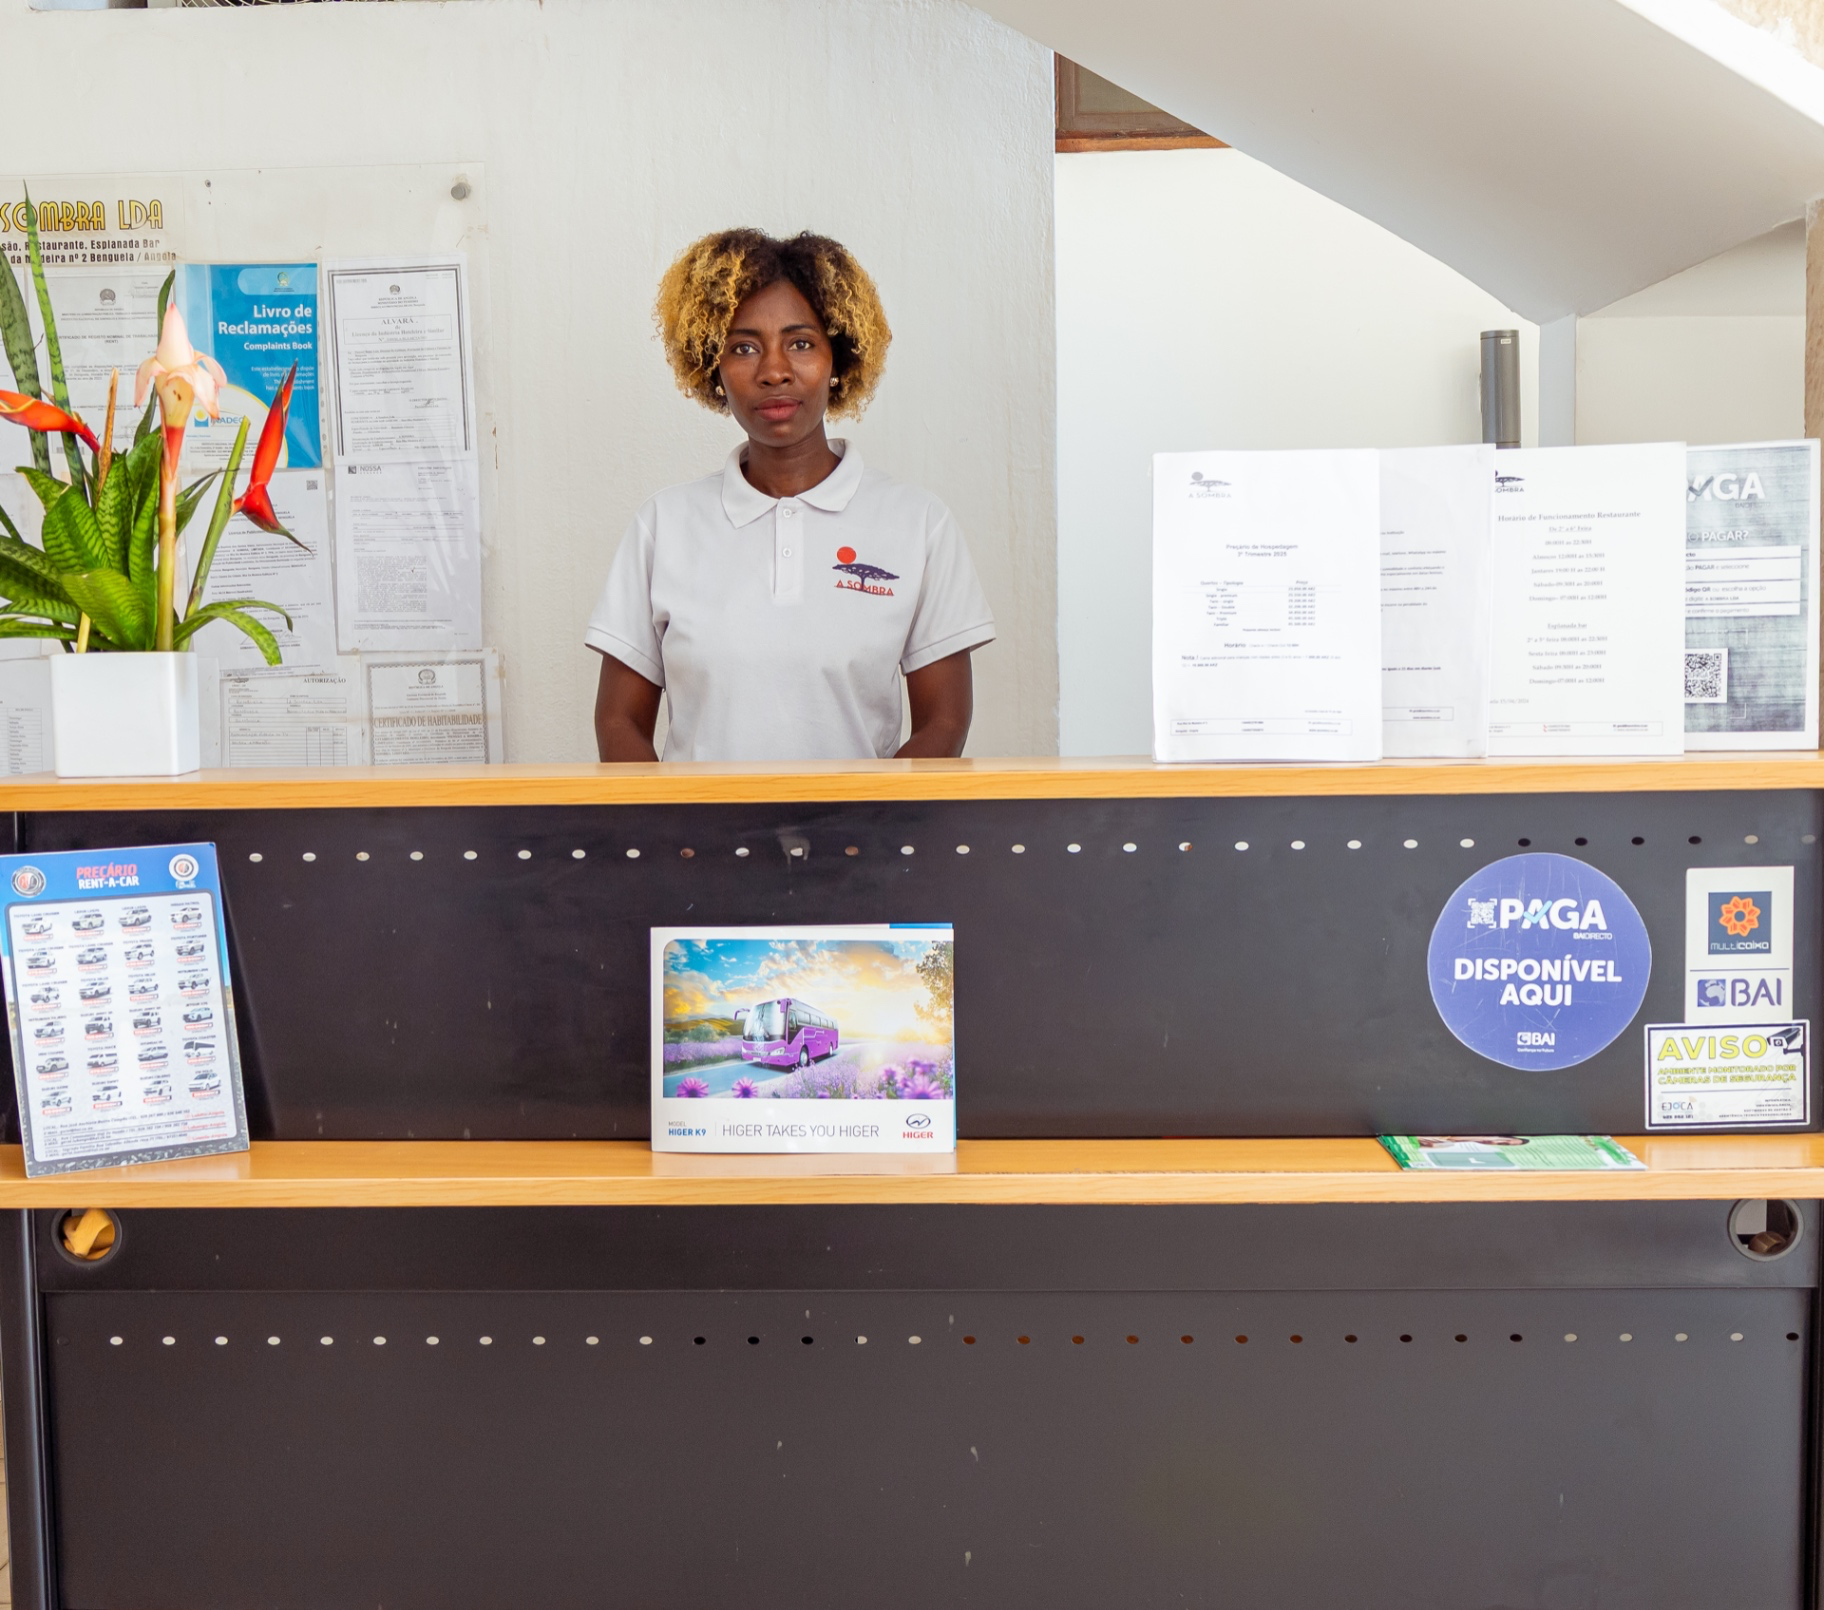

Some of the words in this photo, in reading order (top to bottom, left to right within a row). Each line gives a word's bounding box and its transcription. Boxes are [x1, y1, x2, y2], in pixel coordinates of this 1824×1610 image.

[118, 199, 164, 230] LDA
[2, 240, 21, 252] são.
[24, 240, 88, 251] Rstaurante.
[91, 240, 140, 250] Esplanada
[143, 238, 160, 249] Bar
[10, 254, 22, 264] da
[25, 254, 66, 264] Mdeira
[82, 254, 88, 262] 2
[90, 252, 134, 262] Benguela
[144, 251, 176, 262] Angola
[254, 304, 291, 318] Livro
[294, 304, 312, 318] de
[218, 320, 312, 337] Reclamações
[244, 342, 290, 352] Complaints
[292, 341, 312, 350] Book
[1687, 472, 1765, 502] AGA
[1702, 530, 1749, 542] PAGAR?
[836, 580, 844, 588] A
[847, 580, 894, 596] SOMBRA
[374, 717, 416, 728] CERTIFICADO
[418, 716, 426, 727] DE
[427, 714, 482, 726] HABITABILIDADE
[76, 862, 137, 880] PREÇÁRIO
[79, 876, 140, 890] RENT-A-CAR
[1500, 898, 1607, 930] PAGA
[1455, 954, 1622, 982] DISPONÍVEL
[1500, 983, 1572, 1006] AQUI
[1731, 978, 1781, 1006] BAI
[1532, 1032, 1555, 1045] BAI
[1657, 1034, 1767, 1061] AVISO
[1658, 1067, 1706, 1075] AMBIENTE
[1708, 1065, 1774, 1074] MONITORADO
[1658, 1075, 1710, 1085] CÂMERAS
[1713, 1075, 1727, 1083] DE
[1730, 1073, 1796, 1084] SEGURANÇA
[668, 1128, 694, 1136] HIGER
[695, 1128, 707, 1136] K9
[722, 1124, 762, 1137] HIGER
[766, 1124, 807, 1137] TAKES
[810, 1125, 835, 1137] YOU
[839, 1125, 879, 1137] HIGER
